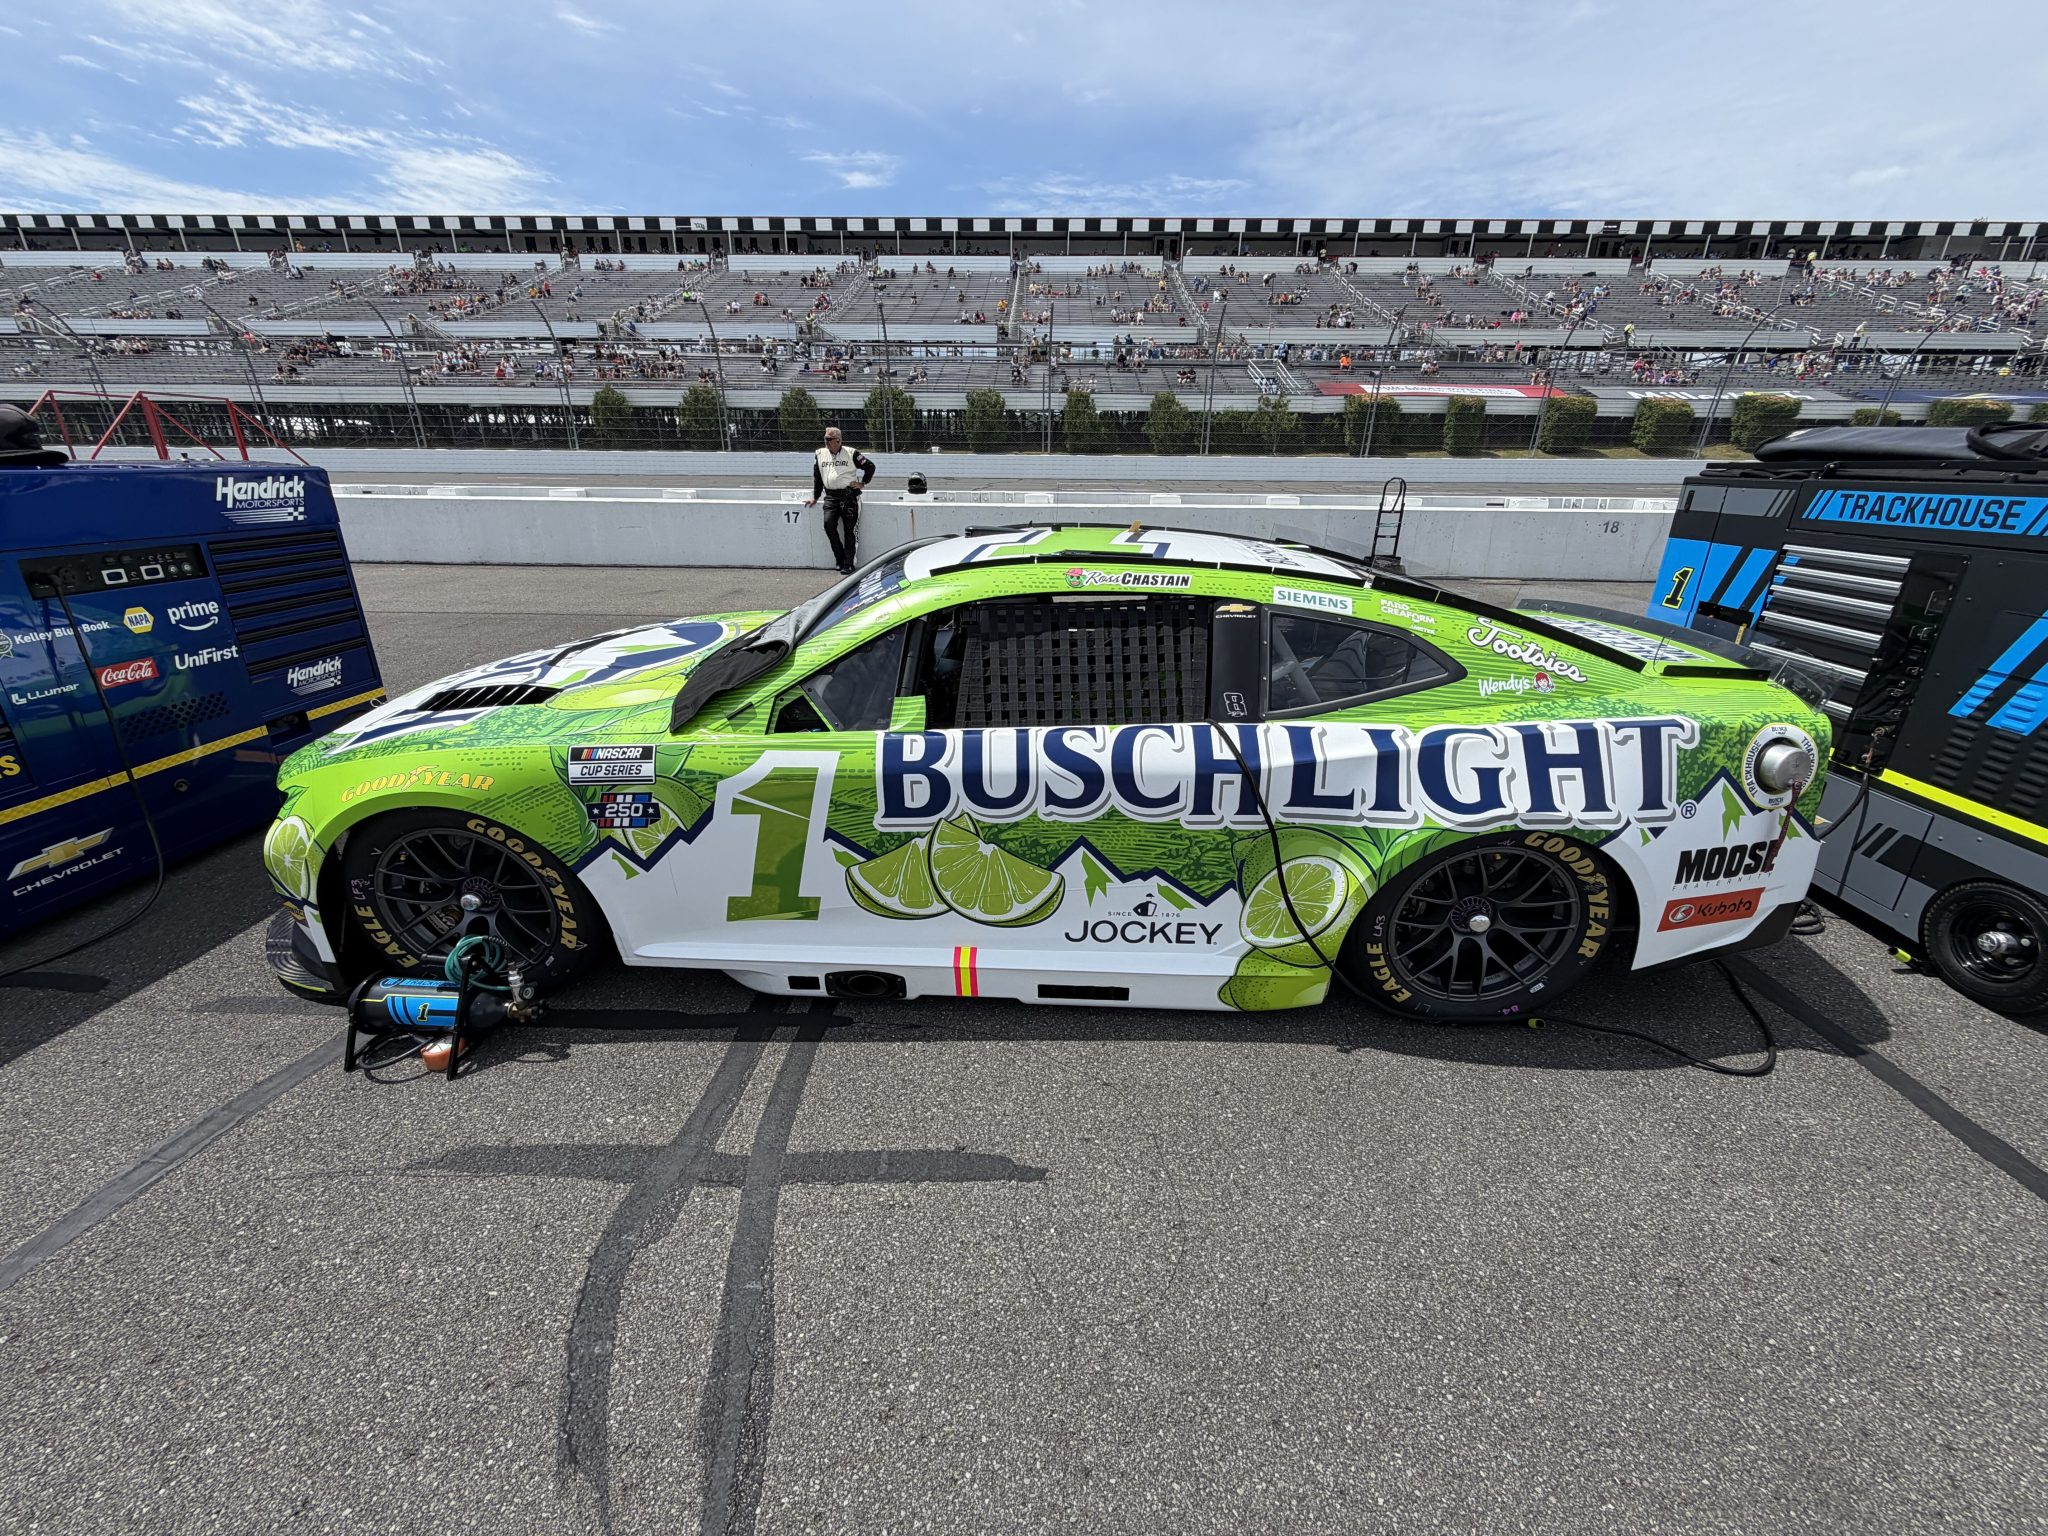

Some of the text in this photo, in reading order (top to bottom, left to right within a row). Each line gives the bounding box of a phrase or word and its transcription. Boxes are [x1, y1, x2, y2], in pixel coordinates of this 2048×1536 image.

[821, 460, 849, 468] OFFICIAL
[216, 475, 305, 509] Hendrick
[235, 498, 305, 509] MOTORSPORTS
[784, 511, 800, 524] 17
[1838, 493, 2027, 530] TRACKHOUSE
[1602, 521, 1620, 534] 18
[1086, 571, 1190, 587] Ross CHASTAIN
[1663, 566, 1693, 609] 1
[167, 601, 219, 624] prime
[1277, 590, 1348, 610] SIEMENS
[13, 631, 52, 645] Kelley
[54, 626, 80, 638] Blu
[81, 620, 111, 633] Book
[127, 613, 151, 627] NAPA
[174, 645, 239, 670] UniFirst
[1467, 616, 1587, 683] Tootsies
[287, 656, 342, 687] Hendrick
[1478, 673, 1530, 697] Wendy's
[596, 748, 642, 759] NASCAR
[580, 764, 642, 776] CUP SERIES
[876, 716, 1698, 830] BUSCH LIGHT
[1745, 740, 1762, 798] TRACKHOUSE
[341, 766, 494, 802] GOODYEAR
[605, 804, 643, 817] 250
[714, 750, 840, 922] 1
[12, 847, 124, 896] CHEVROLET
[466, 819, 577, 949] GOODYEAR
[1672, 872, 1773, 892] FRATERNITY
[1524, 831, 1609, 959] GOODYEAR
[1697, 898, 1752, 917] Kubota
[354, 904, 419, 968] EAGLE
[1064, 920, 1223, 945] JOCKEY
[1367, 943, 1412, 1003] EAGLE
[417, 1002, 430, 1022] 1
